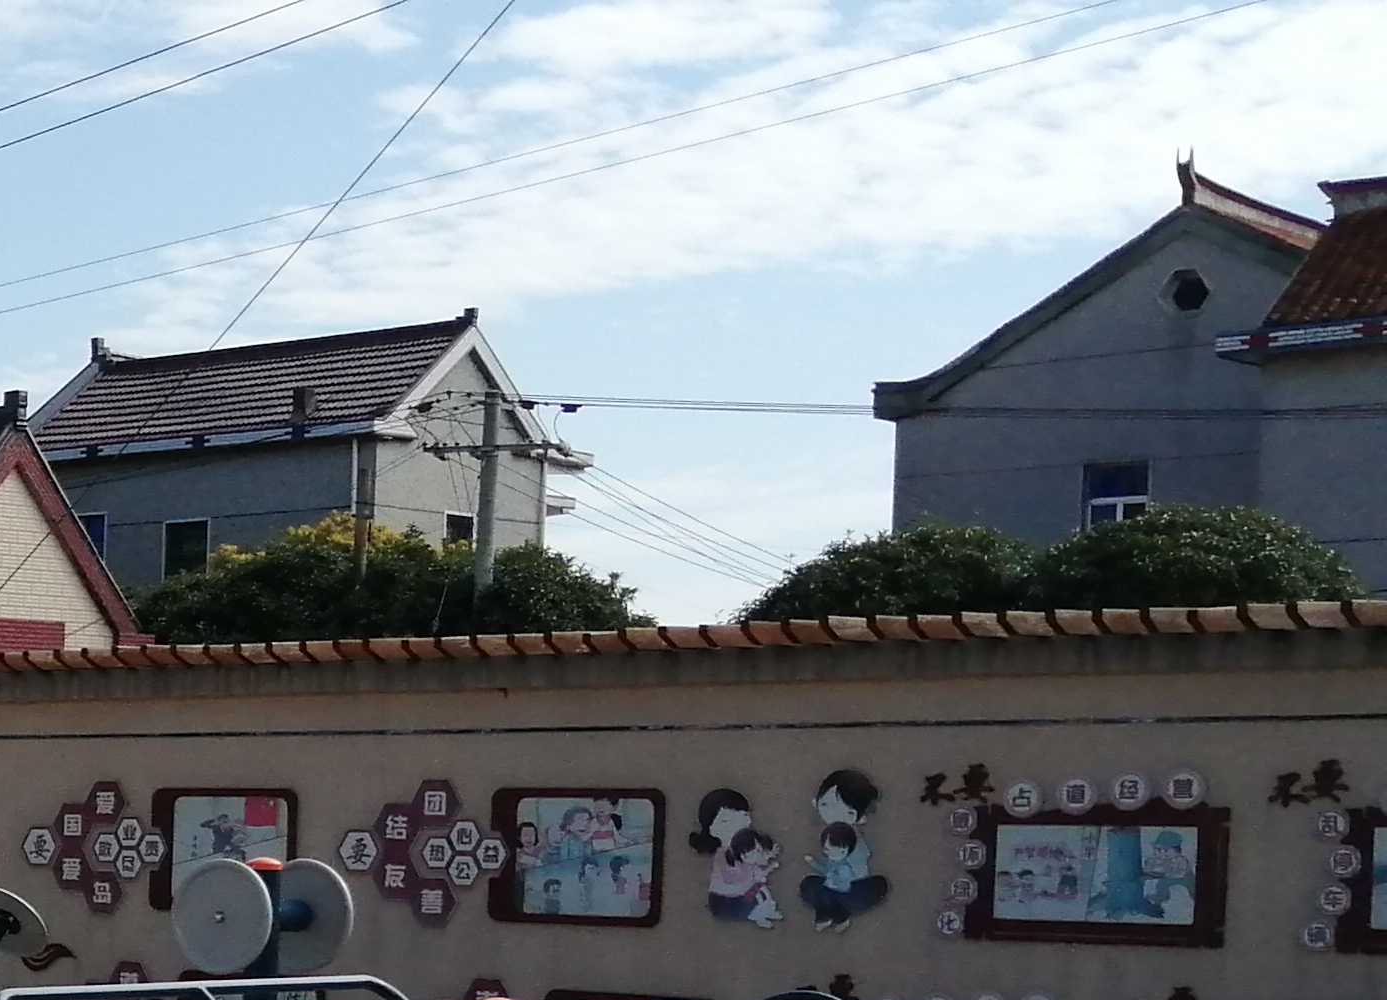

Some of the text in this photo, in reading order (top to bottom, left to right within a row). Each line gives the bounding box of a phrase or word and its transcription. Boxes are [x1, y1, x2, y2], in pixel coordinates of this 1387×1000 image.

[920, 763, 995, 805] 不要
[1013, 778, 1194, 808] 占道经营
[1268, 759, 1350, 807] 不要
[29, 834, 51, 860] 要
[346, 837, 371, 865] 要
